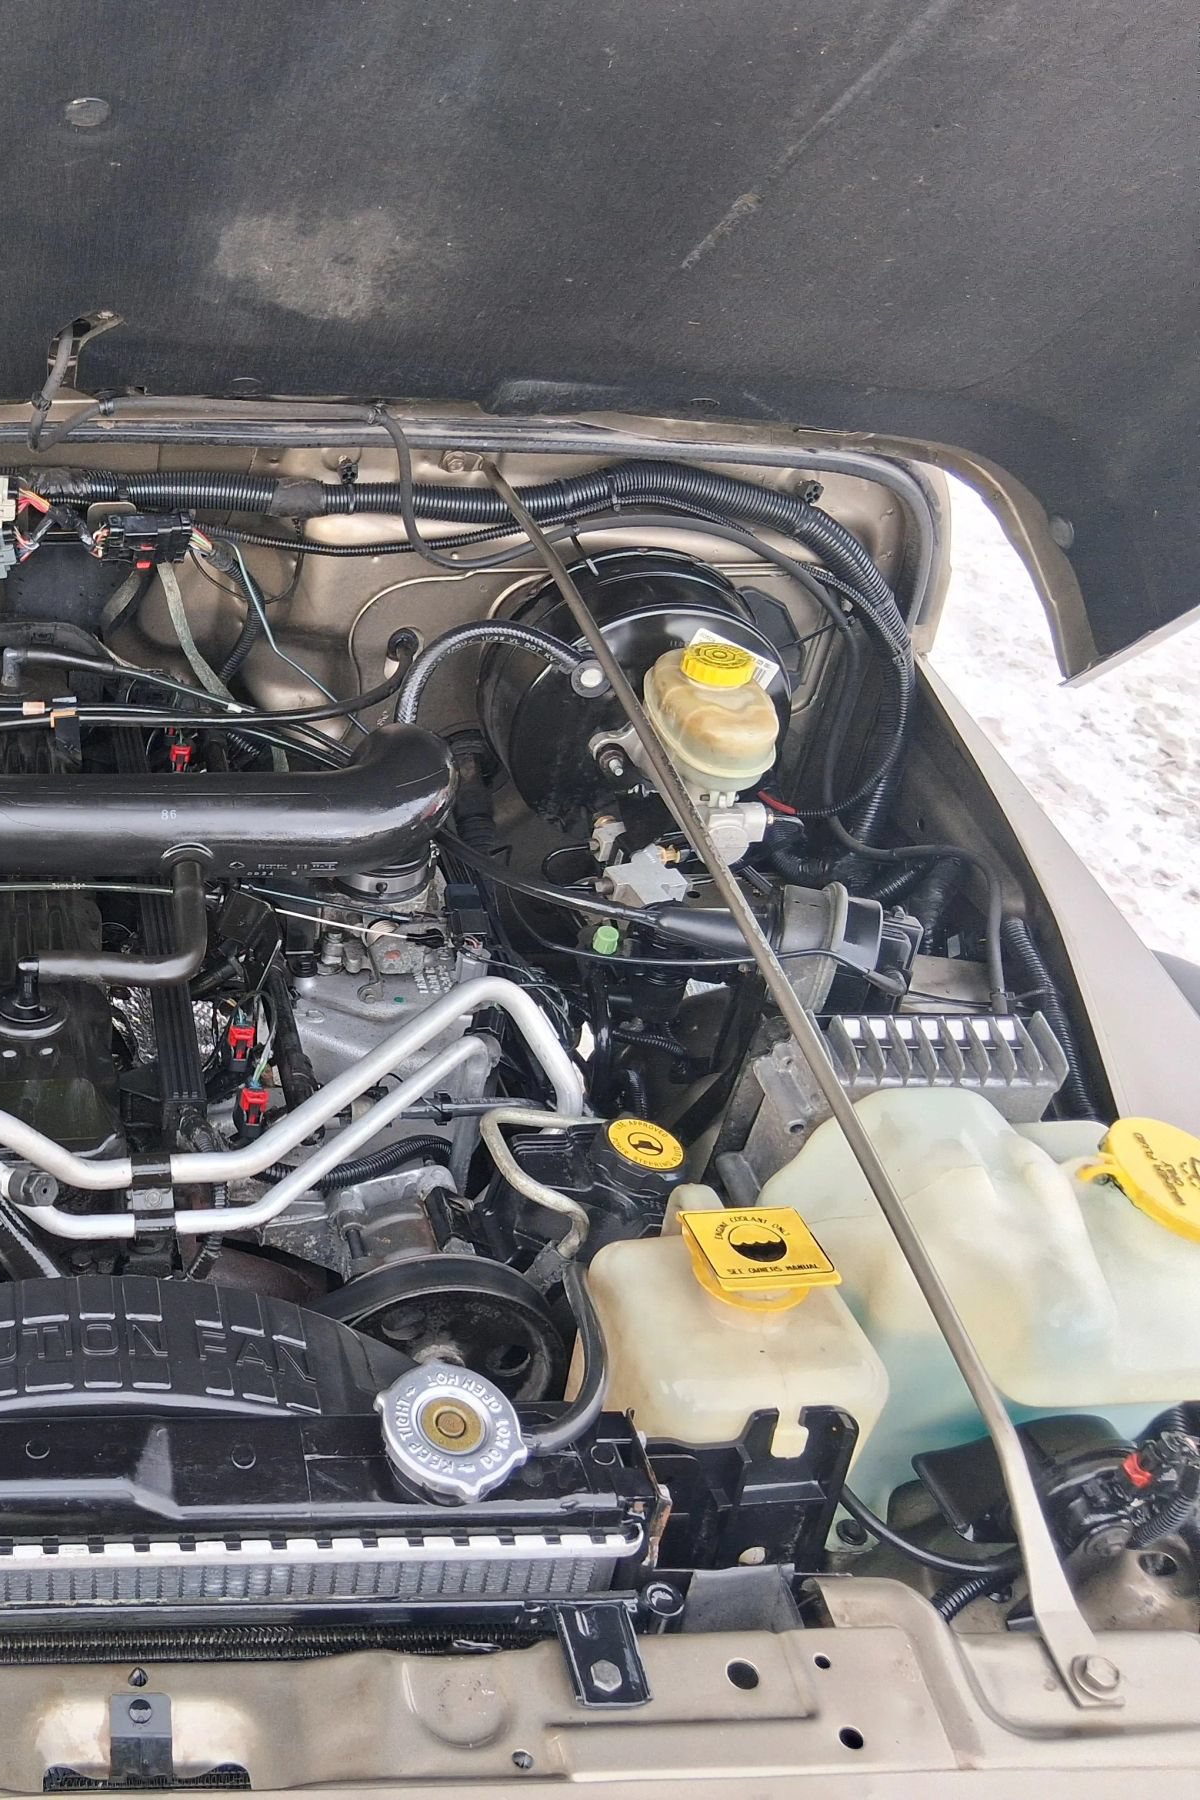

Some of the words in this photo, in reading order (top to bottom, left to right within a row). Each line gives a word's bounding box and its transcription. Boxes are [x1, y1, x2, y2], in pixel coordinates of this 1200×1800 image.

[524, 642, 542, 653] DOT
[160, 809, 177, 820] 86
[628, 1120, 668, 1138] APPROVED
[729, 1215, 768, 1224] COOLANT
[785, 1263, 819, 1272] MANUAL
[196, 1328, 317, 1384] FAN
[427, 1371, 461, 1388] HOT
[461, 1376, 503, 1414] OPEN
[394, 1396, 416, 1441] TIGHT
[408, 1442, 455, 1475] KEEP
